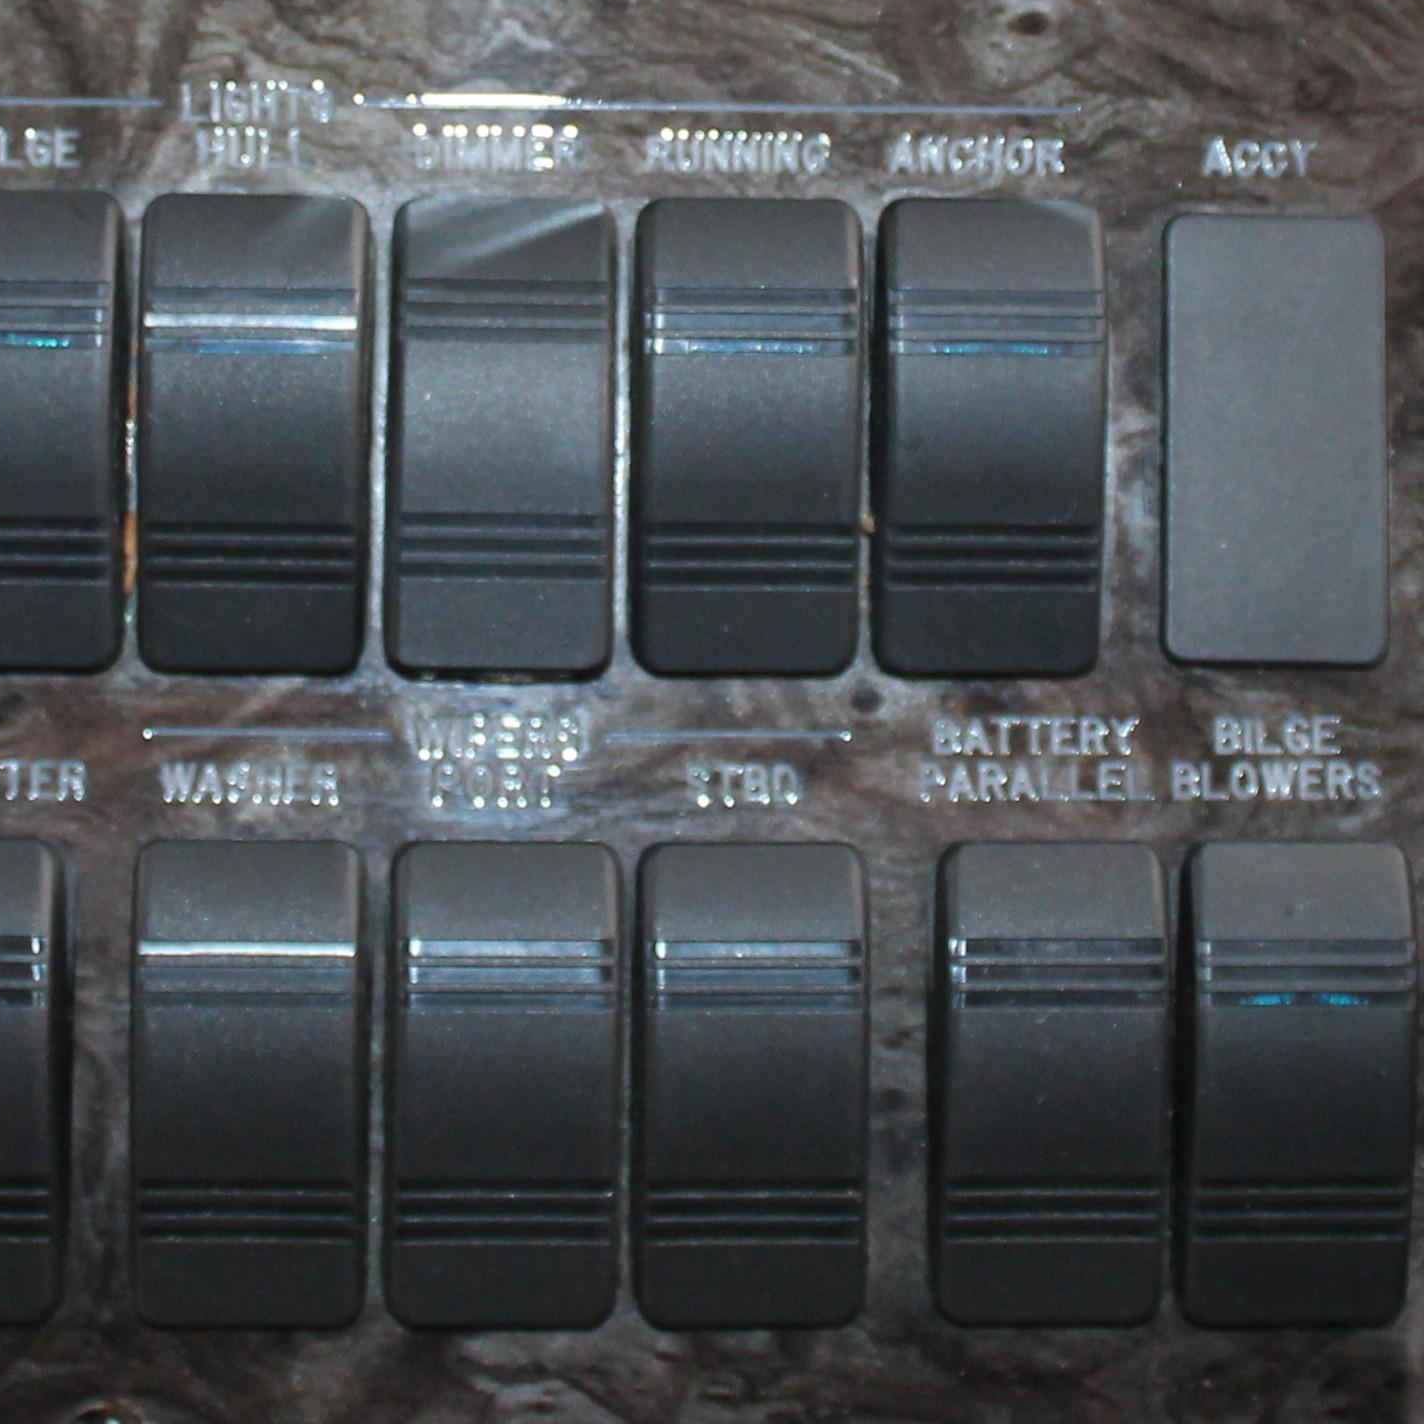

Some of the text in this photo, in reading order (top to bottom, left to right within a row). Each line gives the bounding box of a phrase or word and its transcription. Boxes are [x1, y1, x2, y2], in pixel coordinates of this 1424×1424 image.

[179, 78, 335, 124] LIGHTS
[412, 122, 585, 171] DIMMER
[644, 127, 832, 175] RUNNING
[889, 132, 1067, 177] ANCHOR
[1202, 136, 1319, 179] ACCY
[932, 714, 1141, 757] BATTERY
[1213, 714, 1342, 757] BILGE
[919, 762, 1156, 804] PARALLEL
[1170, 759, 1383, 802] BLOWERS
